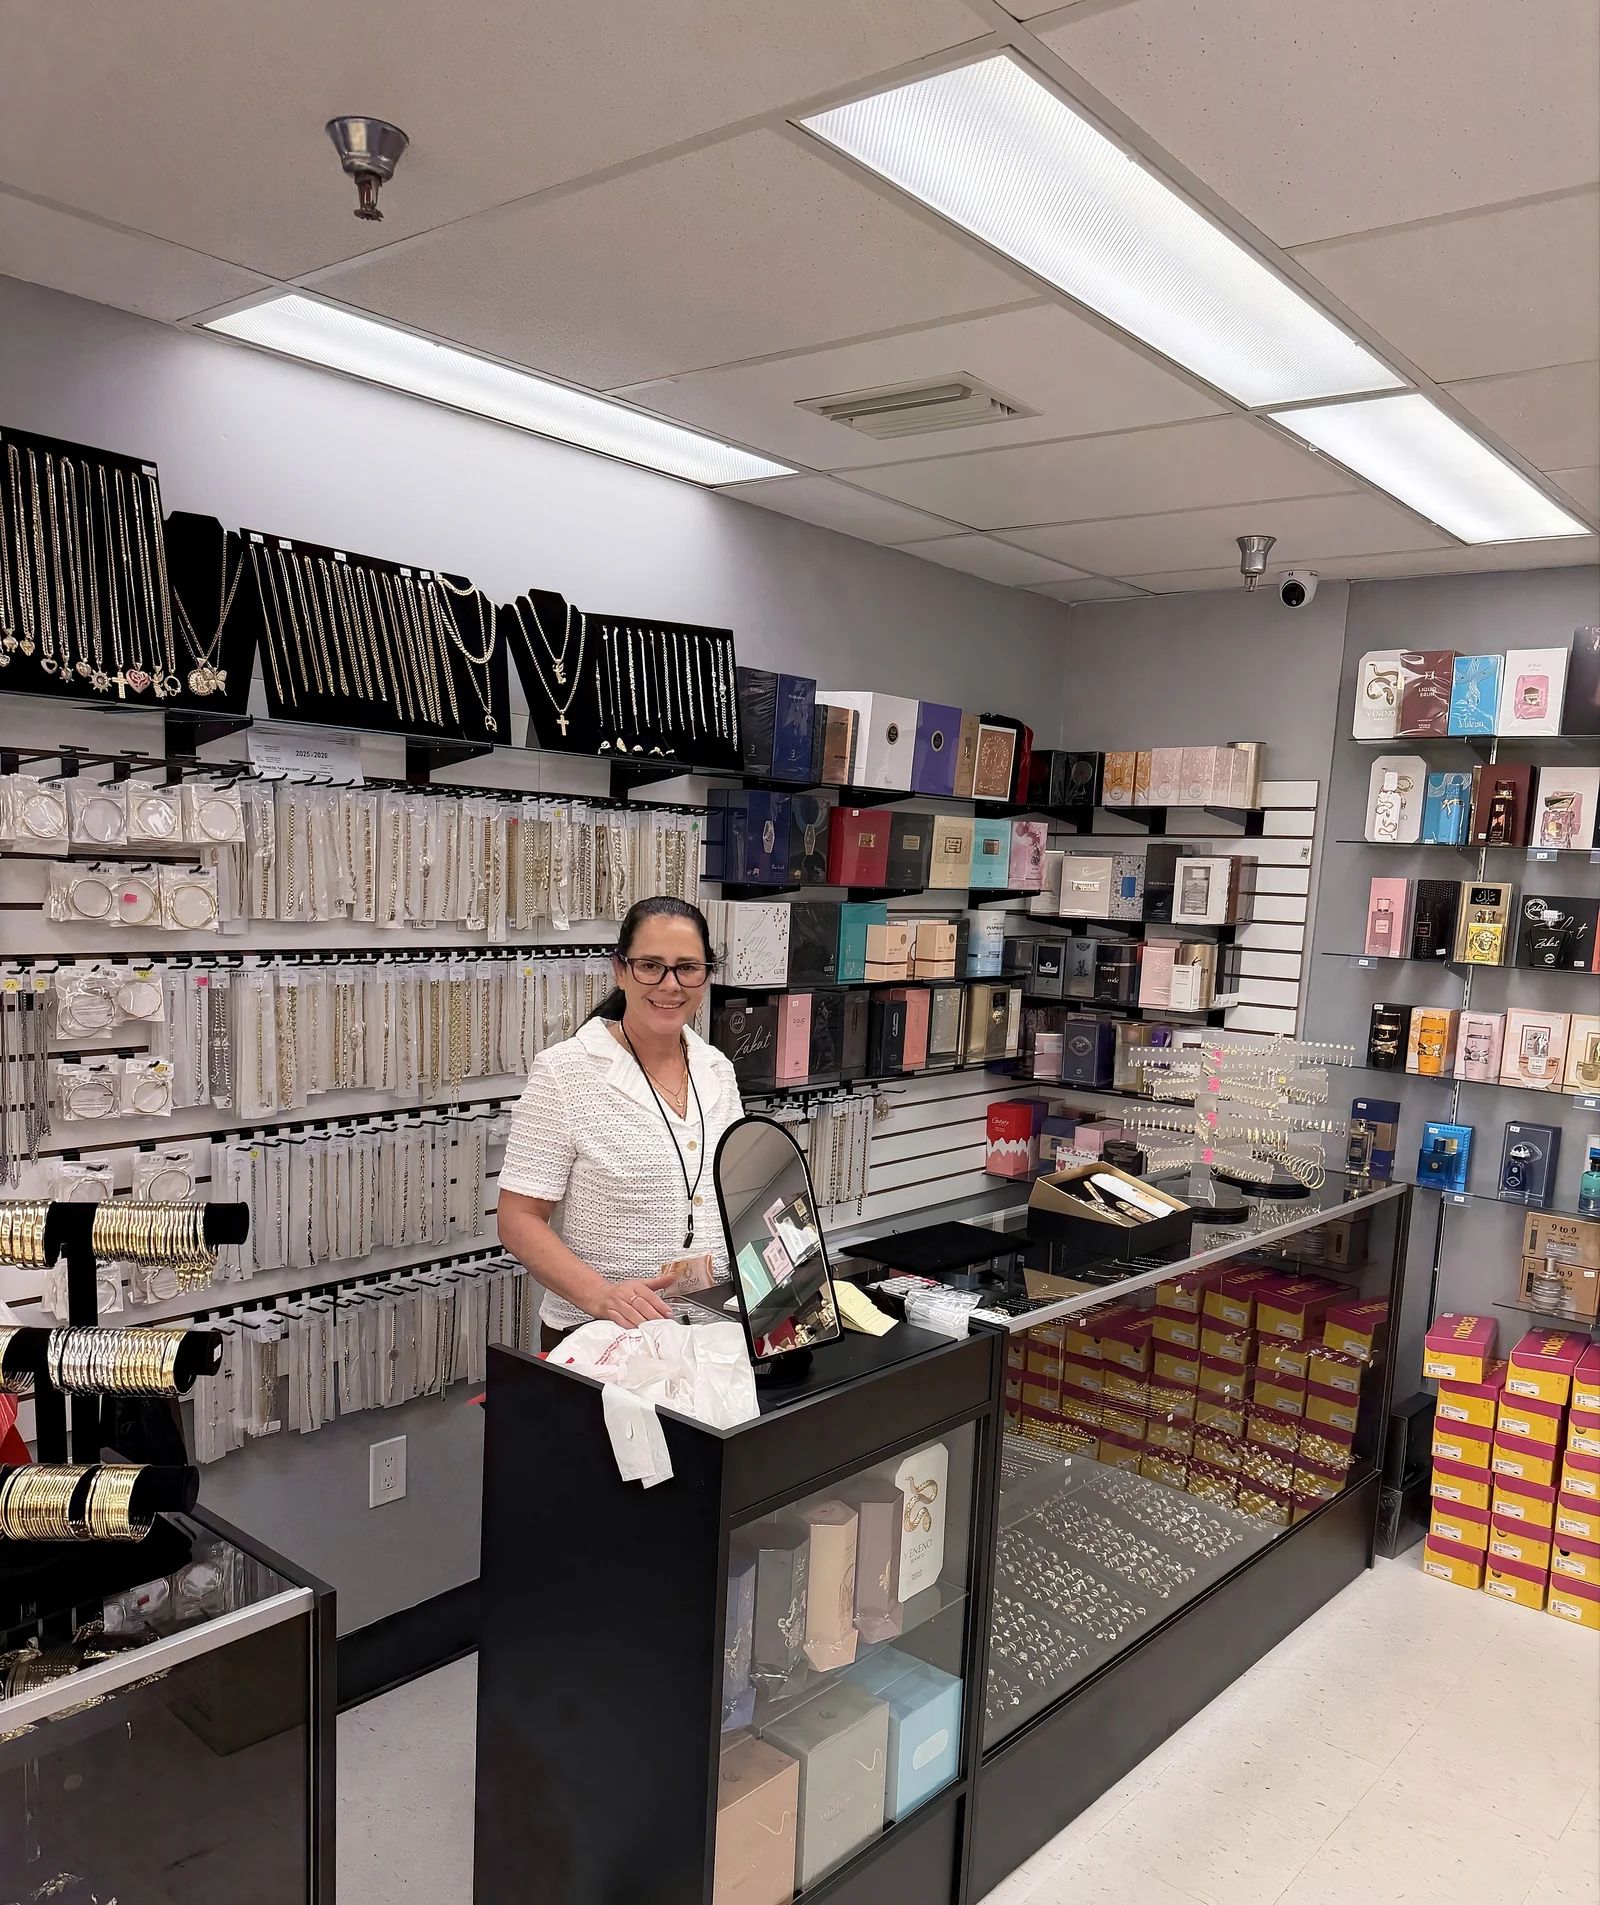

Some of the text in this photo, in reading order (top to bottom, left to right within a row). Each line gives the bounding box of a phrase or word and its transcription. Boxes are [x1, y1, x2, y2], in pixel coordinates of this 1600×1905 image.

[732, 1025, 772, 1062] Zakat
[1551, 1223, 1577, 1235] 9 to 9
[903, 1538, 933, 1560] VENENO
